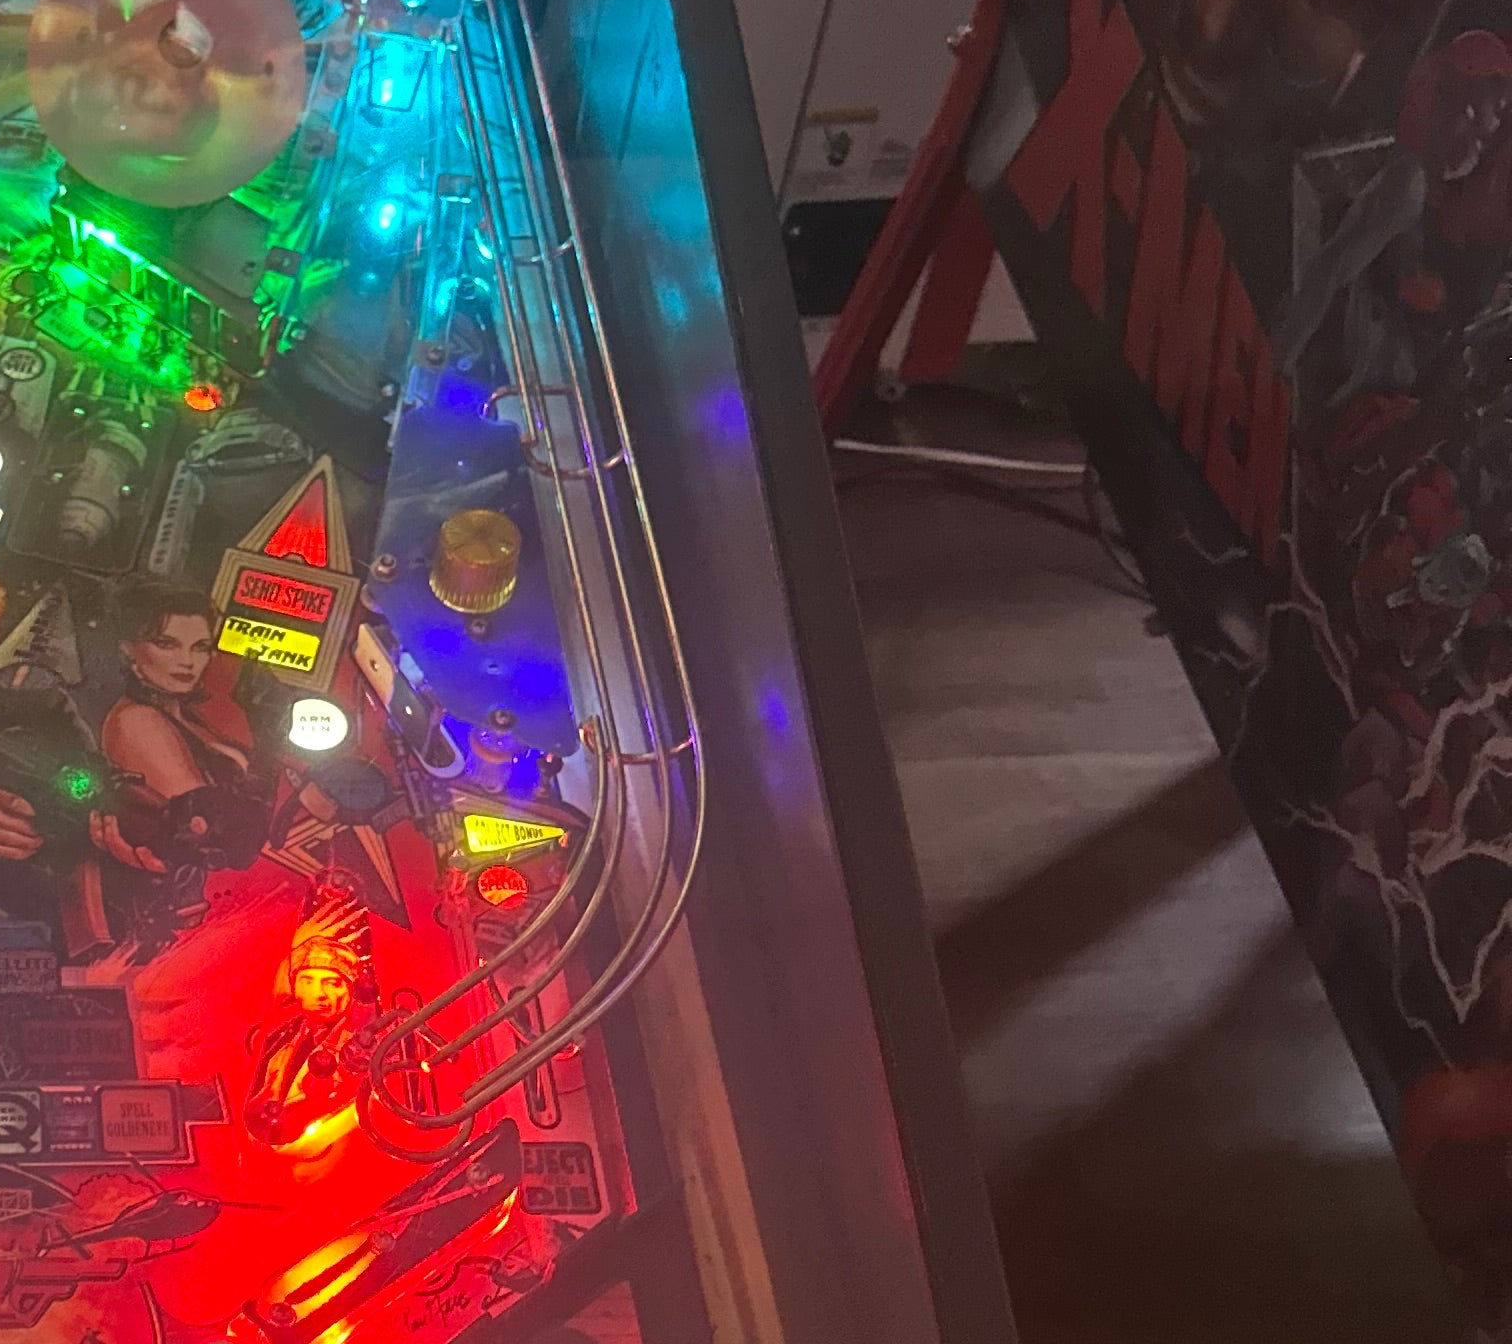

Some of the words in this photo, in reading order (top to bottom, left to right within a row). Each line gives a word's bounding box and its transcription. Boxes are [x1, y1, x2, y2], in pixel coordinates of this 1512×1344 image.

[240, 575, 280, 603] SEND
[284, 586, 329, 616] SPIKE
[226, 618, 287, 642] TRAIN
[513, 825, 544, 842] BONUS
[119, 1102, 154, 1117] SPELL
